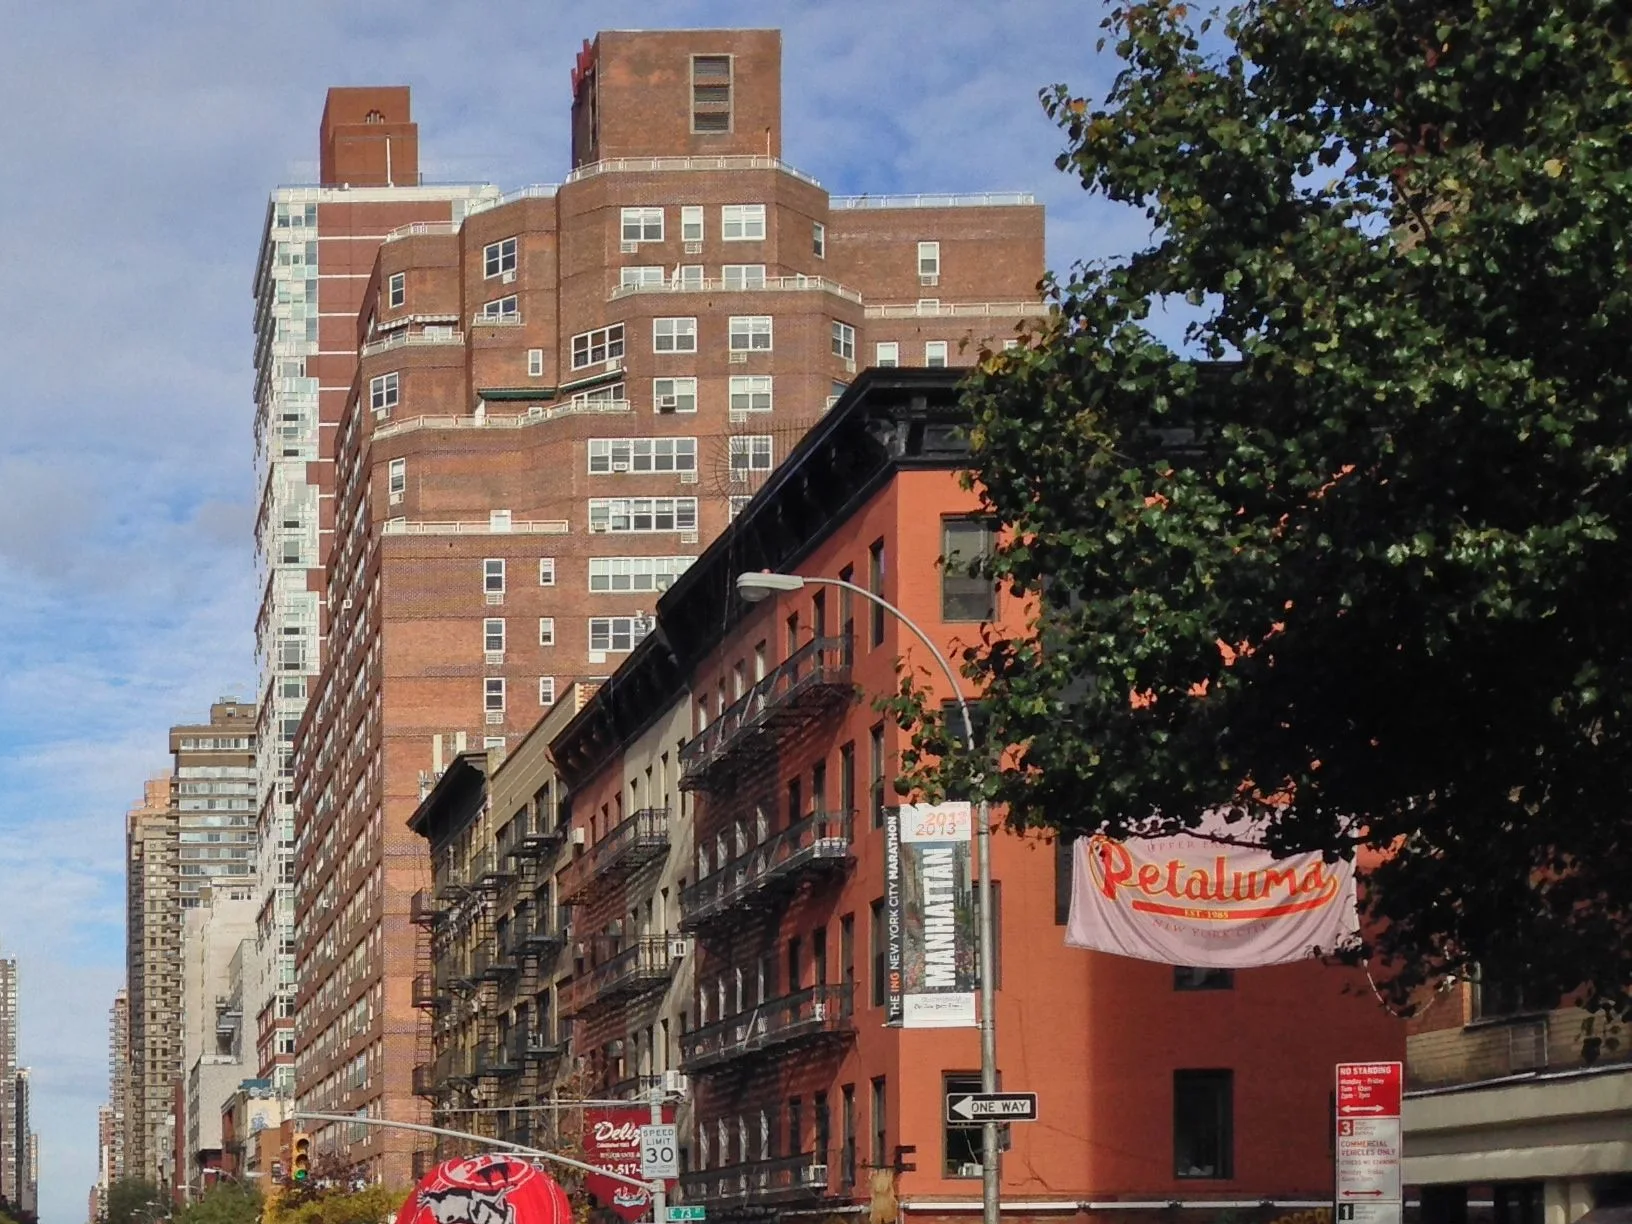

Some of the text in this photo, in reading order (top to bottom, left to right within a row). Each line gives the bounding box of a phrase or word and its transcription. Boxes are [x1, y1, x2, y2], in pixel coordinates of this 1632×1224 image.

[1088, 834, 1330, 902] Petaluma
[887, 816, 900, 1017] THE ING NEW YORK CITY MARATHON
[922, 848, 956, 987] MANHATTAN
[1339, 1066, 1392, 1076] NO STANDING
[971, 1101, 1027, 1113] ONE WAY
[643, 1128, 674, 1137] SPEED
[1341, 1121, 1351, 1136] 3
[646, 1138, 671, 1146] LIMIT
[646, 1147, 674, 1164] 30
[680, 1207, 692, 1218] 73
